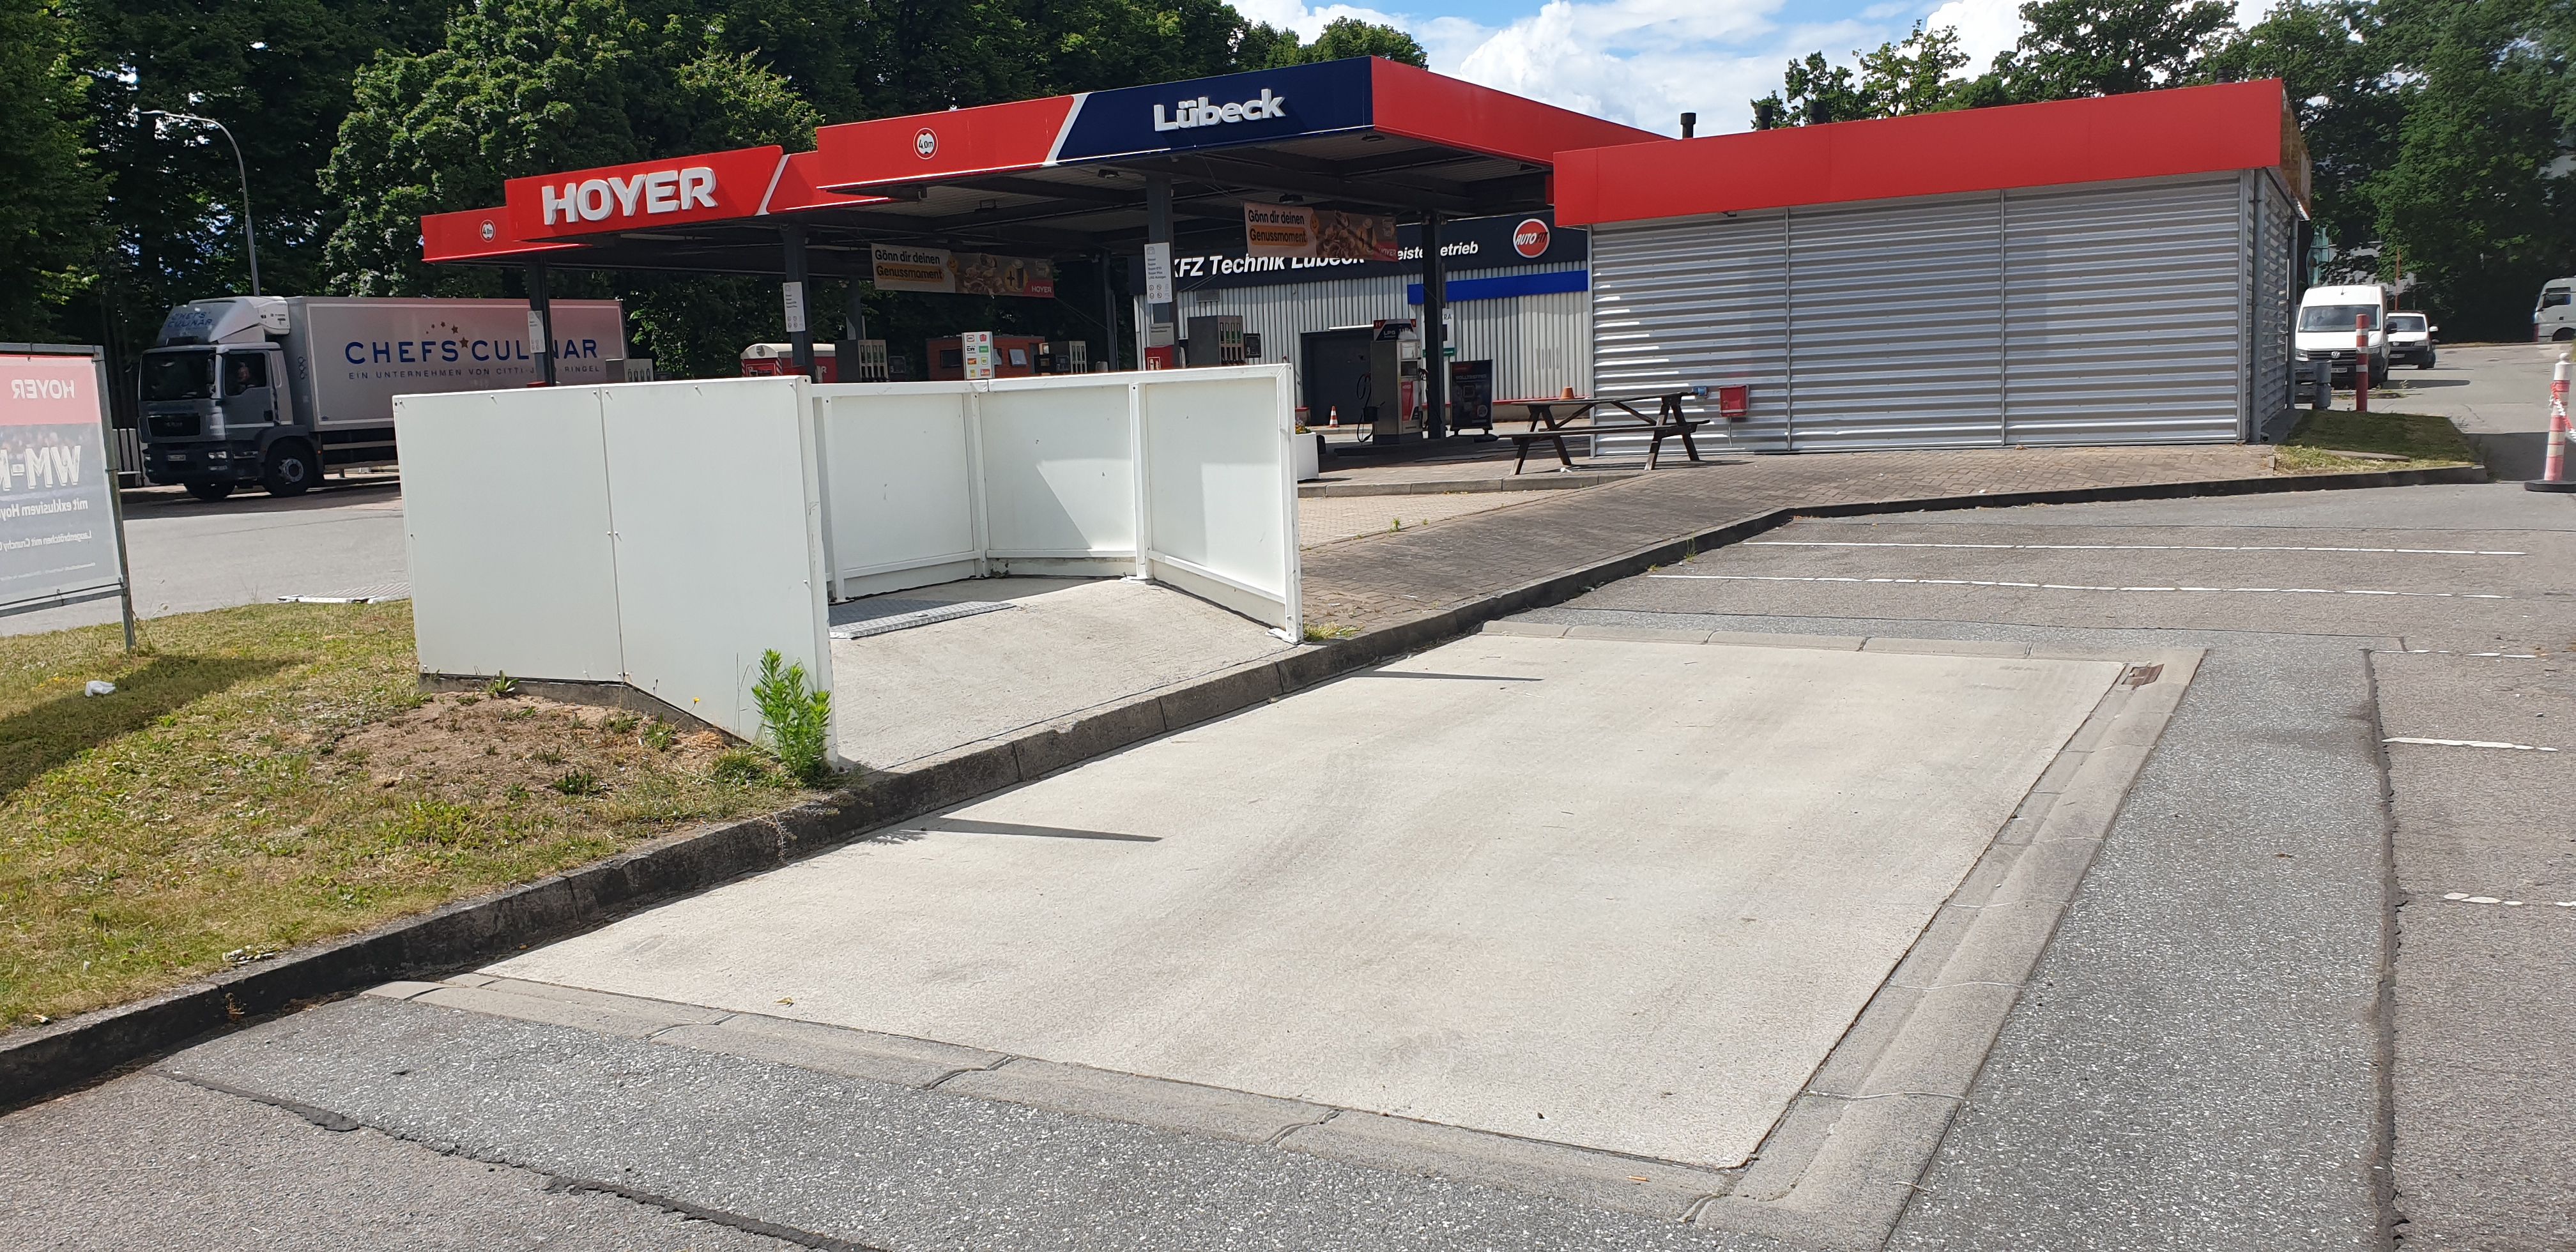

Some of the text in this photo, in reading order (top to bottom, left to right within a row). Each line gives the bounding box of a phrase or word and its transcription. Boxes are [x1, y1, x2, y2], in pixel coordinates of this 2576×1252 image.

[1154, 88, 1286, 132] Lübeck
[542, 167, 719, 225] HOYER
[1248, 209, 1305, 225] Gönn dir deinen
[1250, 227, 1307, 243] Genussmoment
[875, 249, 940, 264] Gönn dir deinen
[877, 265, 944, 280] Genussmoment
[1174, 257, 1204, 277] KFZ
[1209, 253, 1285, 276] Technik
[1031, 286, 1052, 294] HOYER
[345, 339, 598, 364] CHEFS CULAR
[376, 369, 462, 378] UNTERNEHMEN
